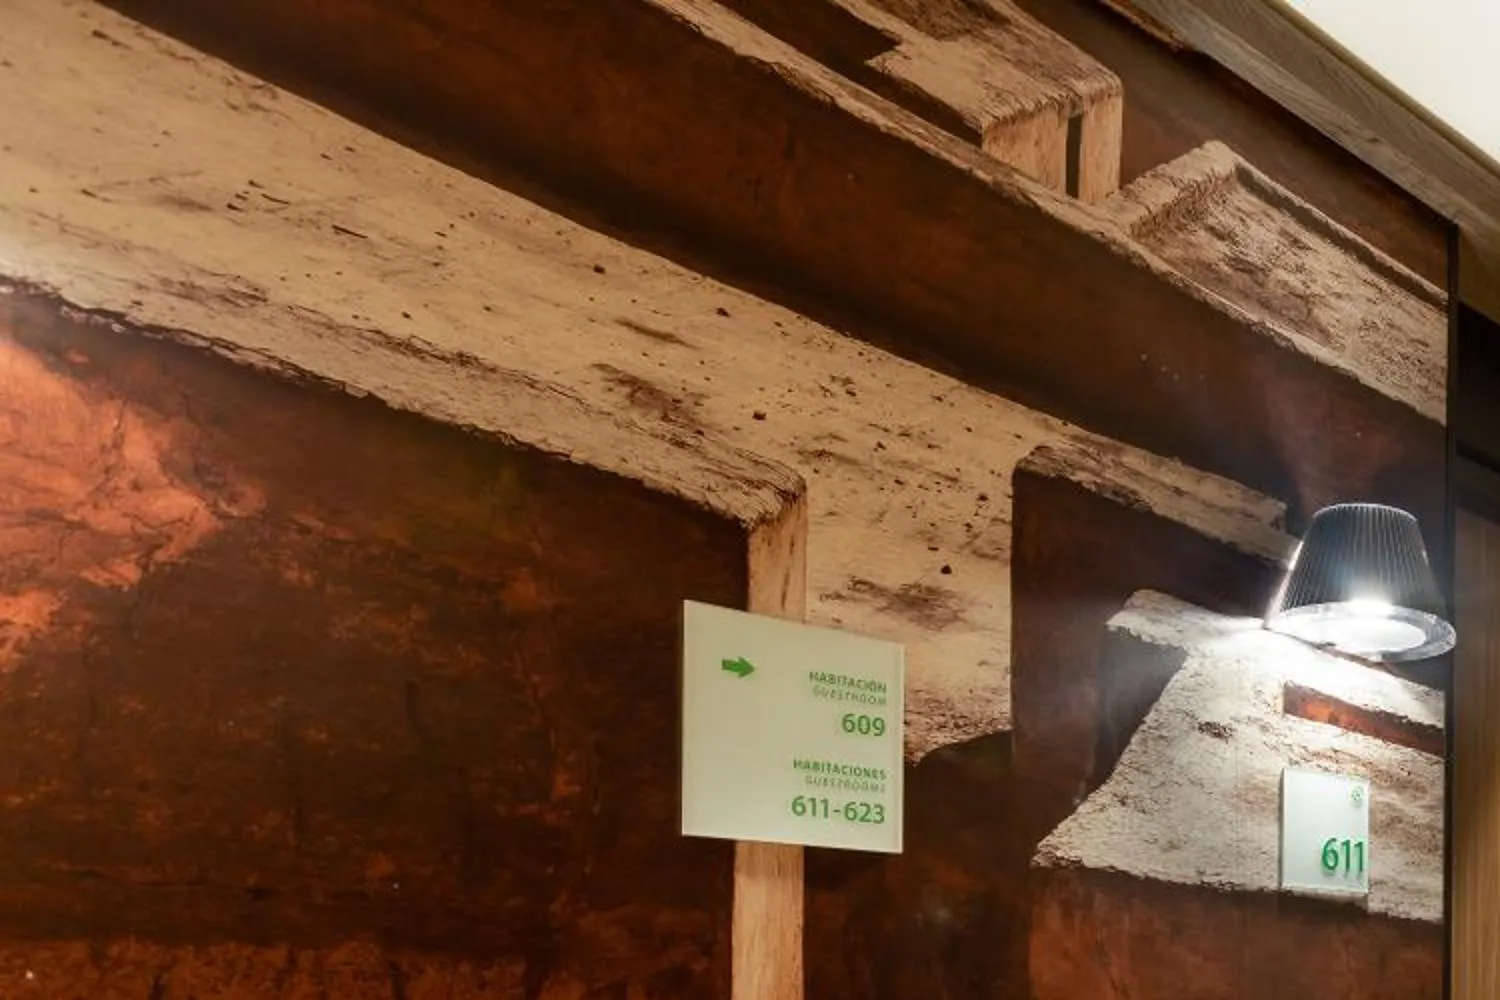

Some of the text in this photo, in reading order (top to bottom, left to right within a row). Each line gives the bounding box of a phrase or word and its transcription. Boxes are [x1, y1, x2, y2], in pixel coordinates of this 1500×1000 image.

[841, 712, 886, 737] 609
[793, 759, 887, 781] HABITACIONES
[791, 795, 885, 825] 611-623
[1322, 836, 1364, 871] 611
